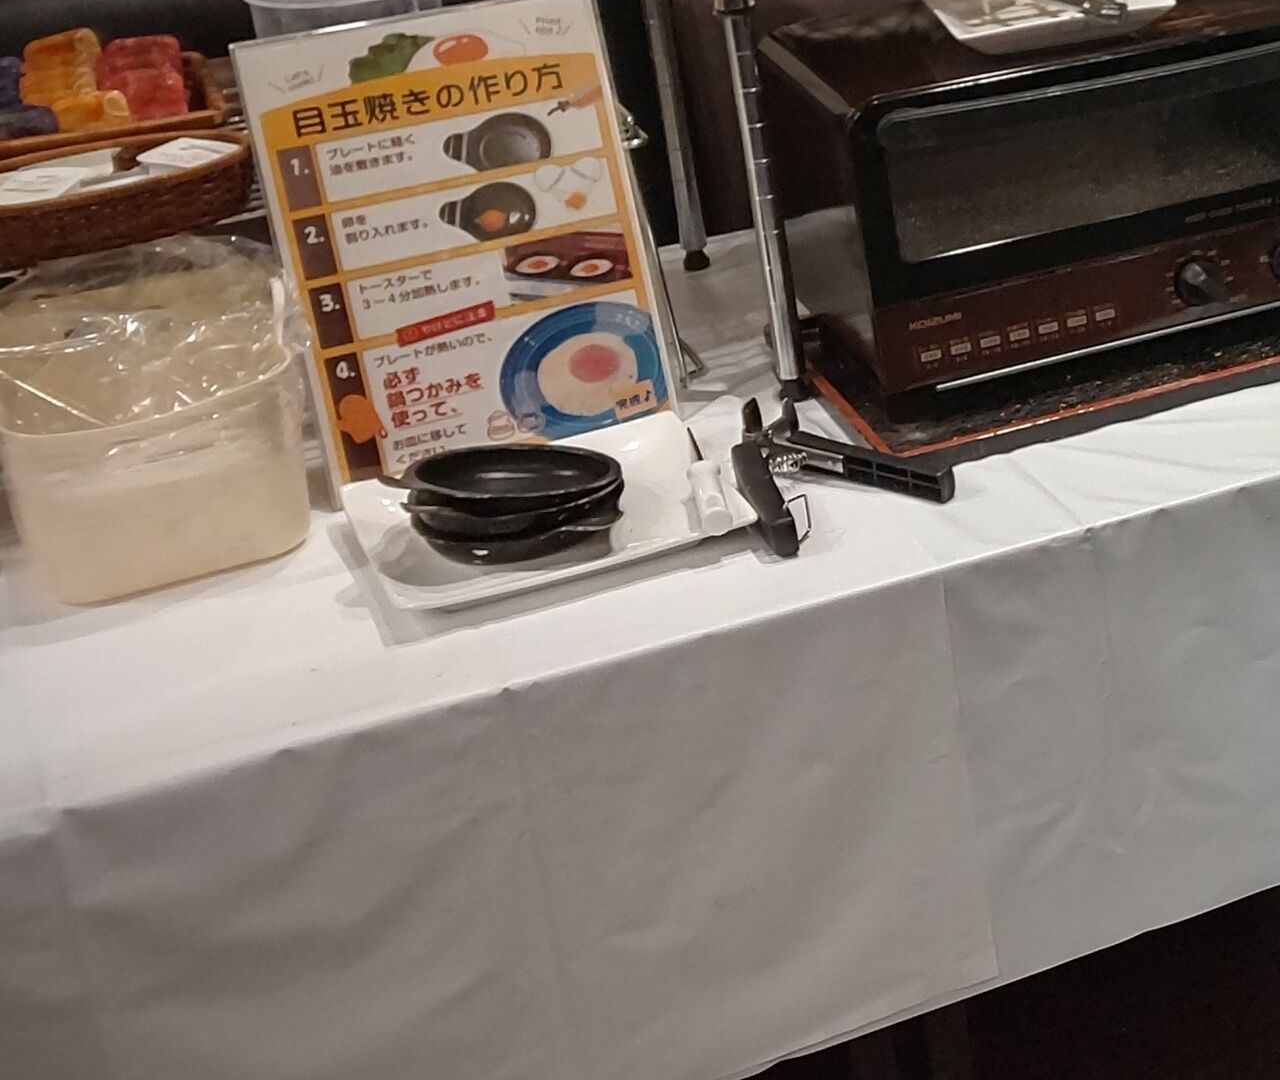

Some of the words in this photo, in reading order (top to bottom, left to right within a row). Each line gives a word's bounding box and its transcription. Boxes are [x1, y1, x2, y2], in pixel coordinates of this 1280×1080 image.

[291, 63, 564, 138] 目玉焼きの作り方
[303, 225, 326, 245] 2.
[358, 269, 433, 295] トースターで
[317, 293, 341, 313] 3.
[374, 332, 494, 368] プレートが熱いので、
[383, 366, 420, 390] 必ず
[386, 372, 484, 408] 鍋つかみを
[391, 401, 458, 428] 使って、
